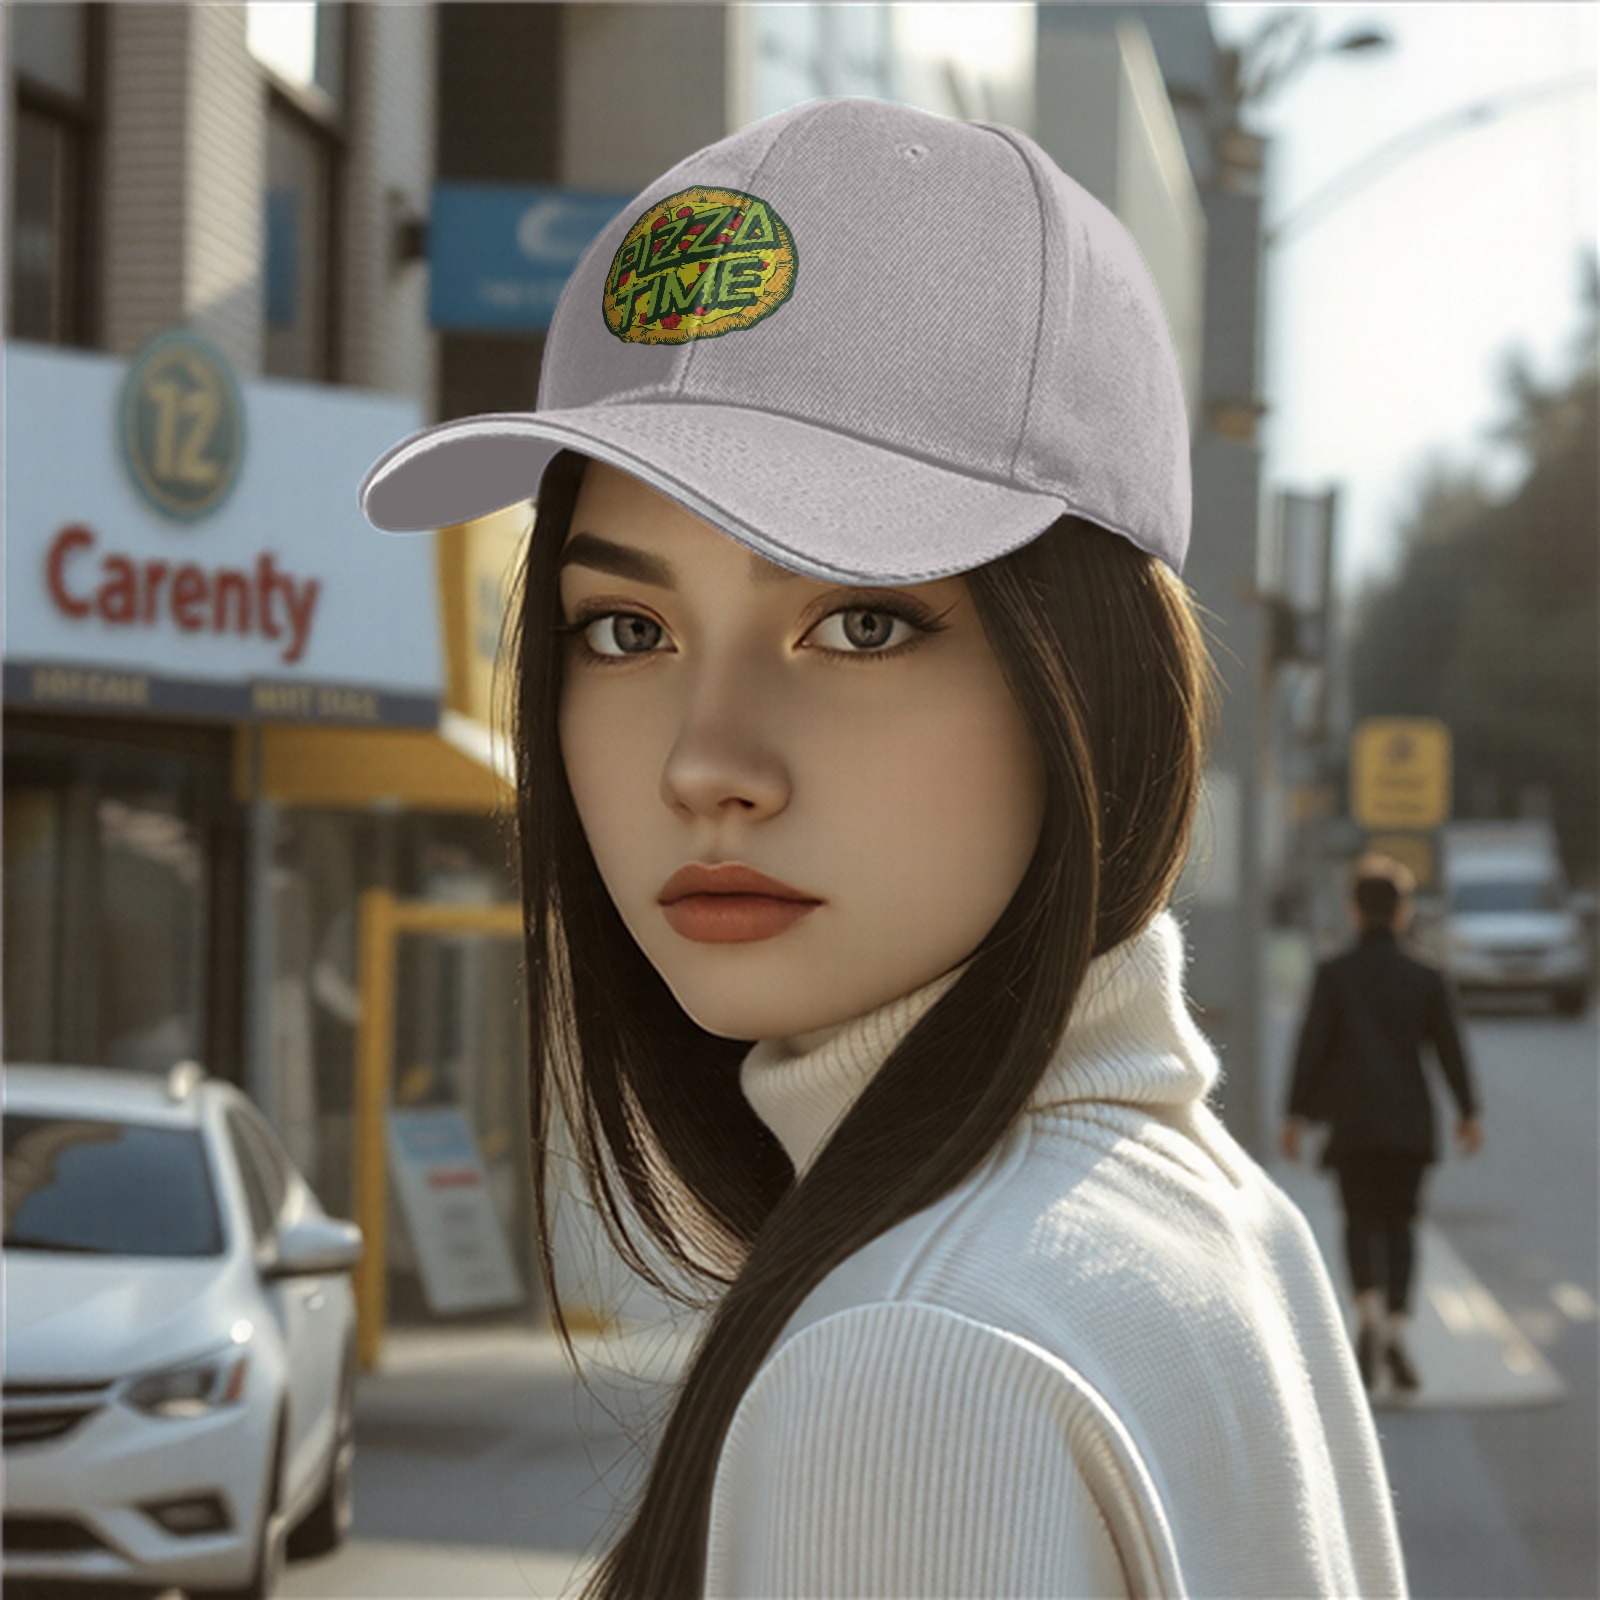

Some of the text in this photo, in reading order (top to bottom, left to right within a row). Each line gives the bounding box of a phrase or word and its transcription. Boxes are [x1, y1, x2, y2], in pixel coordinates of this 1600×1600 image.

[612, 201, 777, 291] PIZZA
[614, 256, 761, 331] TIME
[46, 522, 319, 665] Carenty
